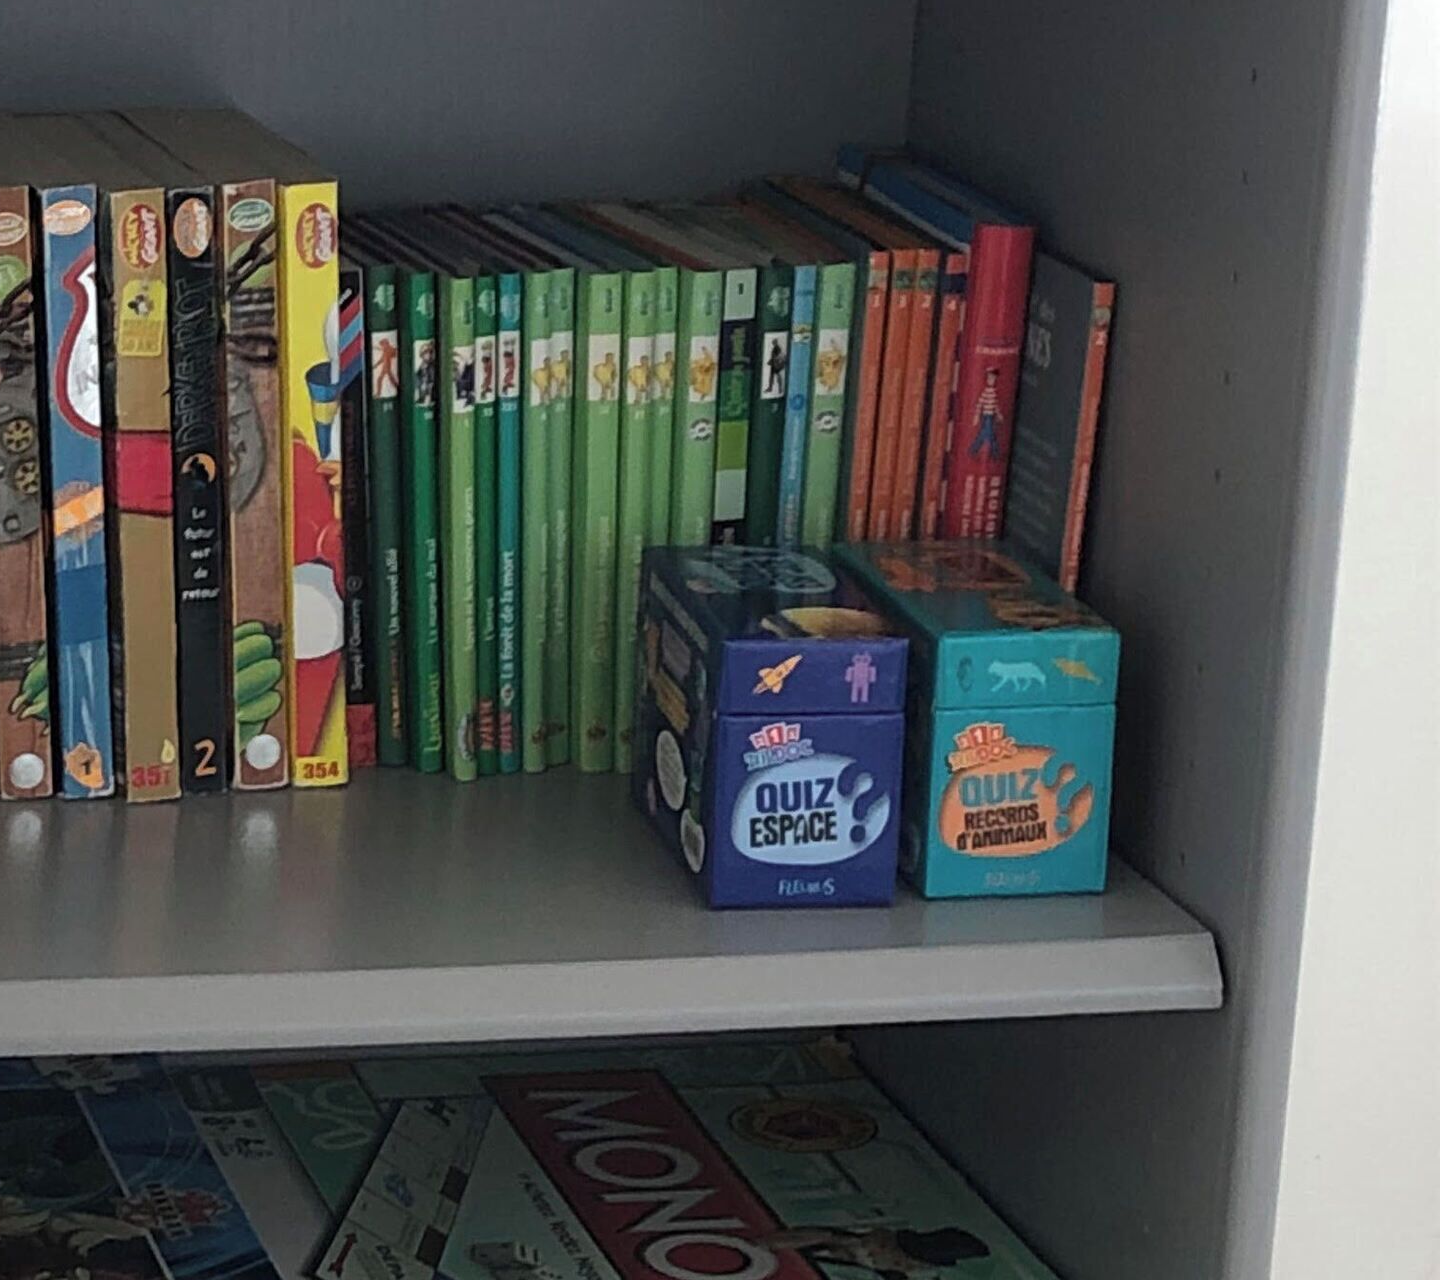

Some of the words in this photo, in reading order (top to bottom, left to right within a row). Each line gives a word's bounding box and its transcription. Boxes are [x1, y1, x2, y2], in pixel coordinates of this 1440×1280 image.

[501, 550, 515, 588] mort
[501, 589, 514, 603] la
[501, 605, 514, 624] de
[500, 625, 514, 661] forêt
[502, 662, 514, 679] La
[194, 738, 217, 778] 2
[302, 761, 338, 779] 354
[755, 777, 835, 813] QUIZ
[960, 767, 1039, 808] QUIZ
[749, 809, 838, 848] ESPACE
[963, 802, 1040, 831] RECORDS
